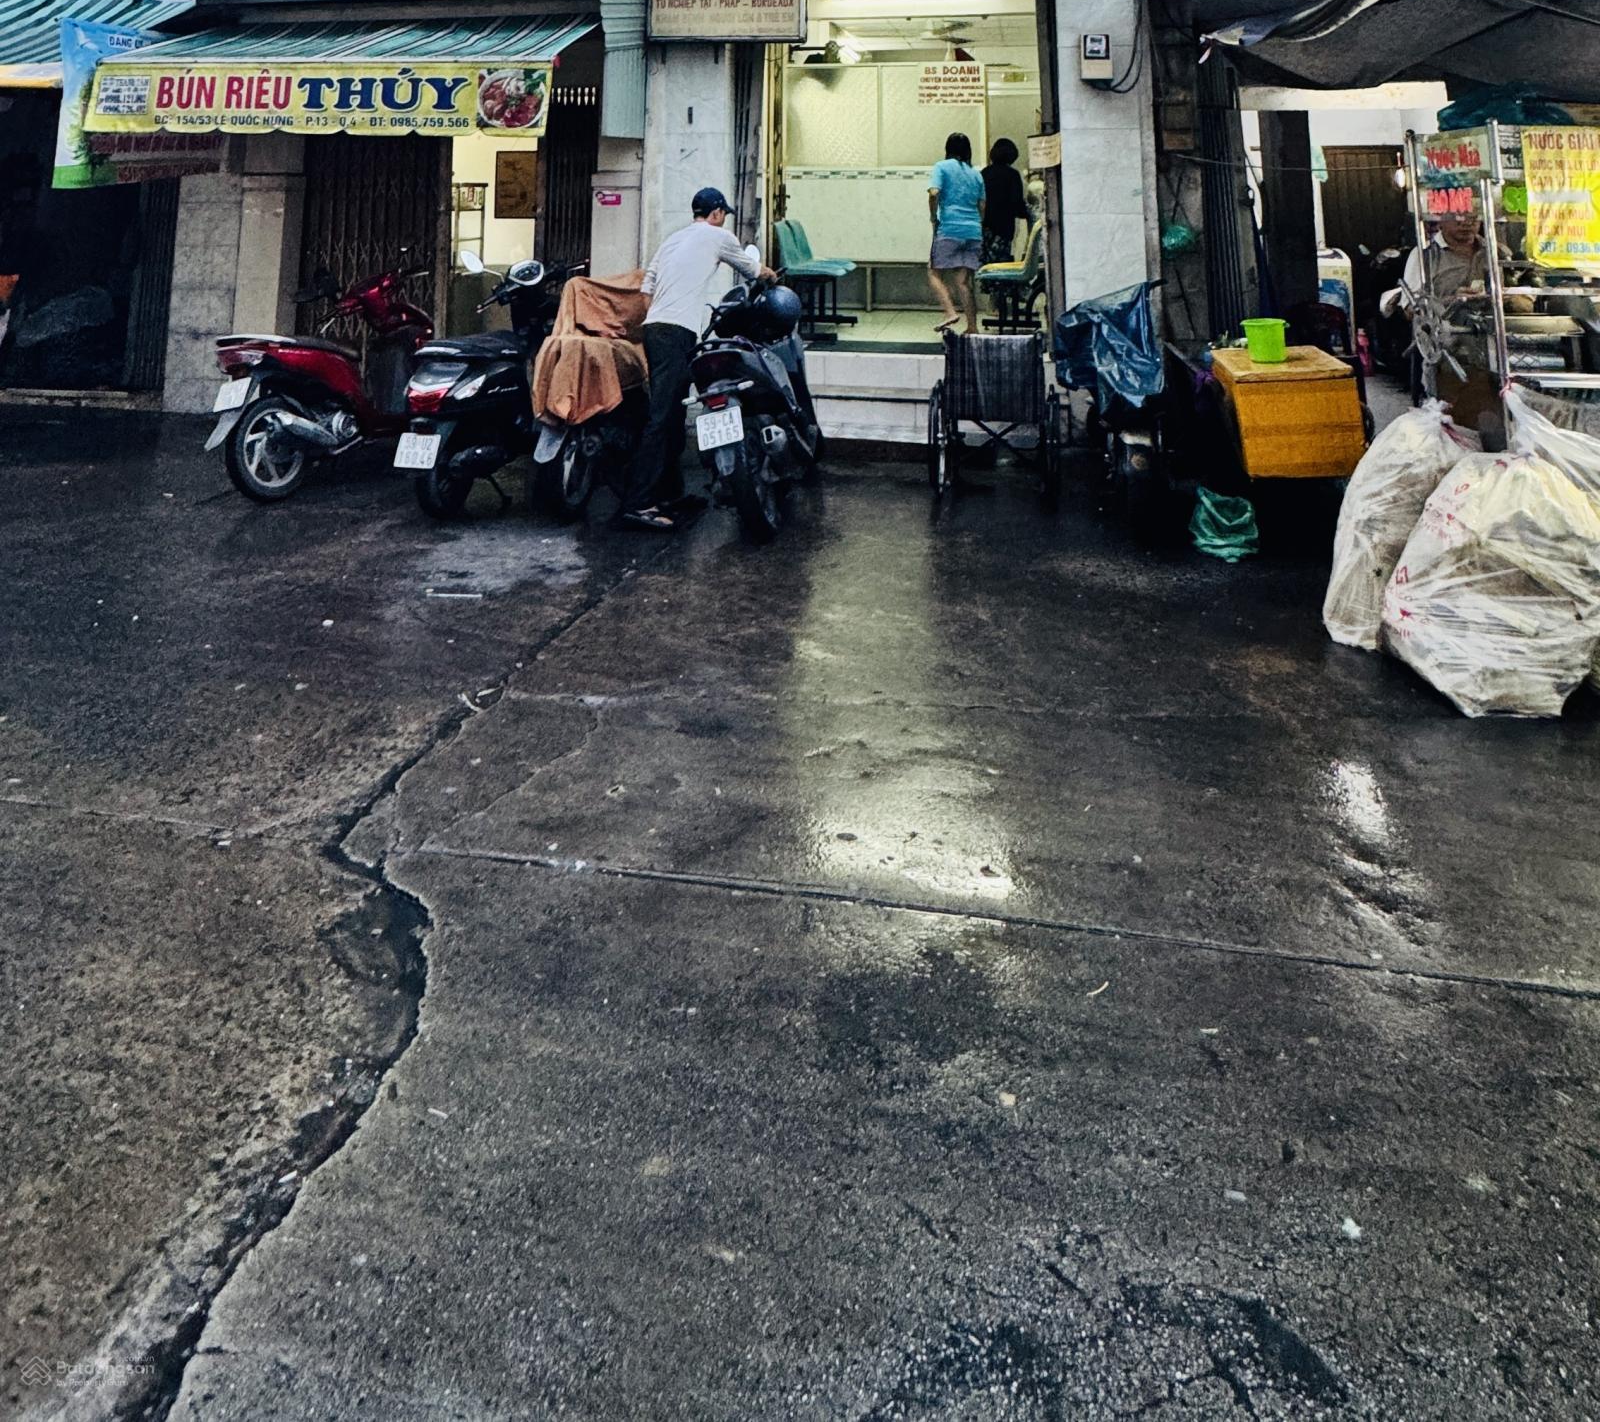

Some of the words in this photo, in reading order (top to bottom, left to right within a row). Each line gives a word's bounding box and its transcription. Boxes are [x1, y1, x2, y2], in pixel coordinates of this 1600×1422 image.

[943, 66, 980, 75] DOANH
[155, 68, 217, 109] BÚN
[224, 68, 293, 109] RIÊU
[390, 116, 470, 127] 0985.759.566
